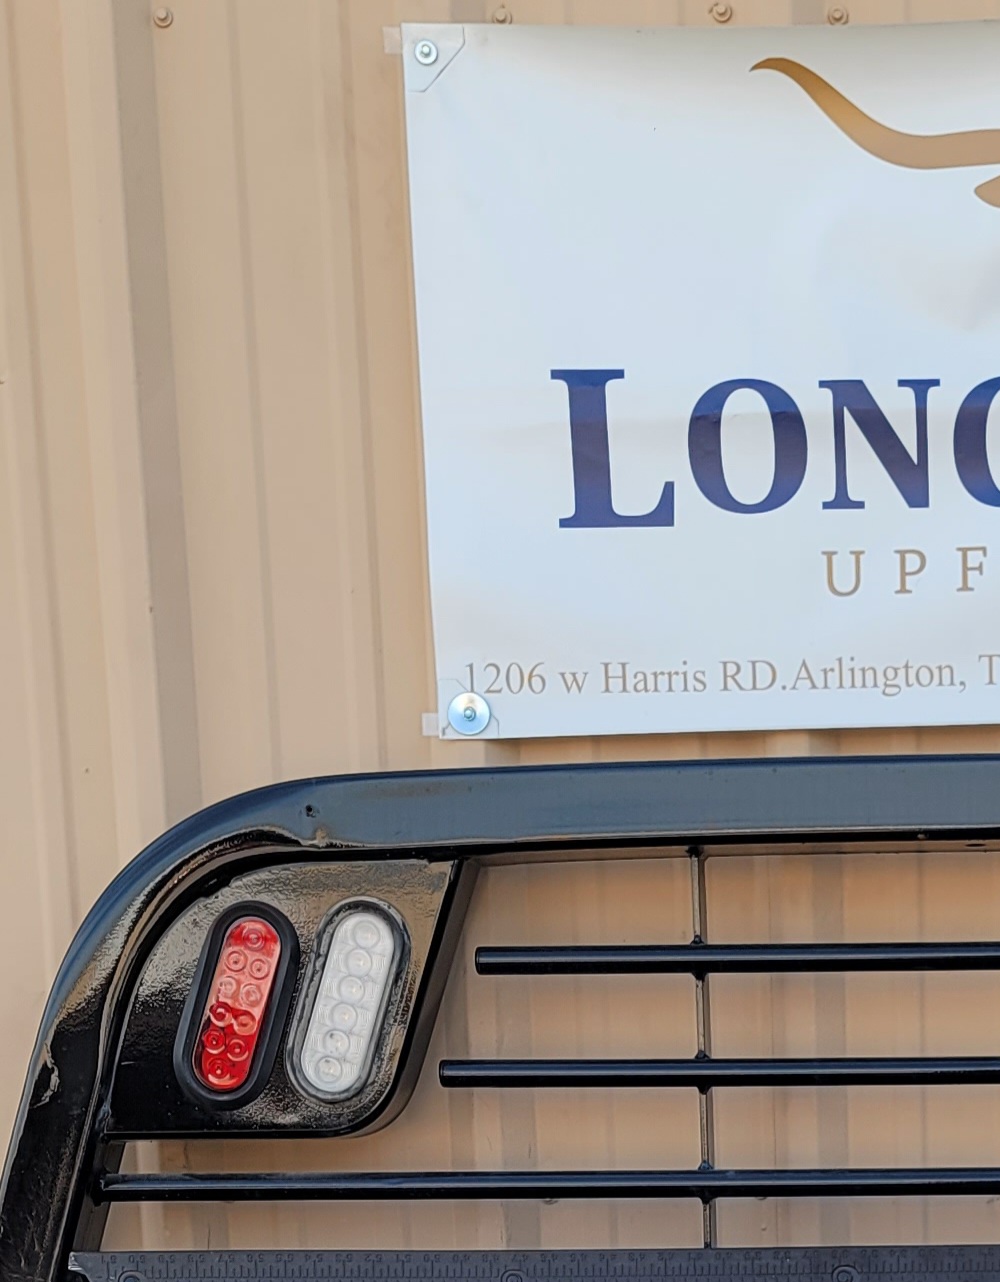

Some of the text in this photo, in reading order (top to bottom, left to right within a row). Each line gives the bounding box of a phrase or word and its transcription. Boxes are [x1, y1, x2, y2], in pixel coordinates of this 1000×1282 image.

[465, 661, 547, 695] 1206
[558, 671, 590, 695] w
[600, 659, 708, 694] Harris
[718, 656, 967, 698] RD.Arlington,
